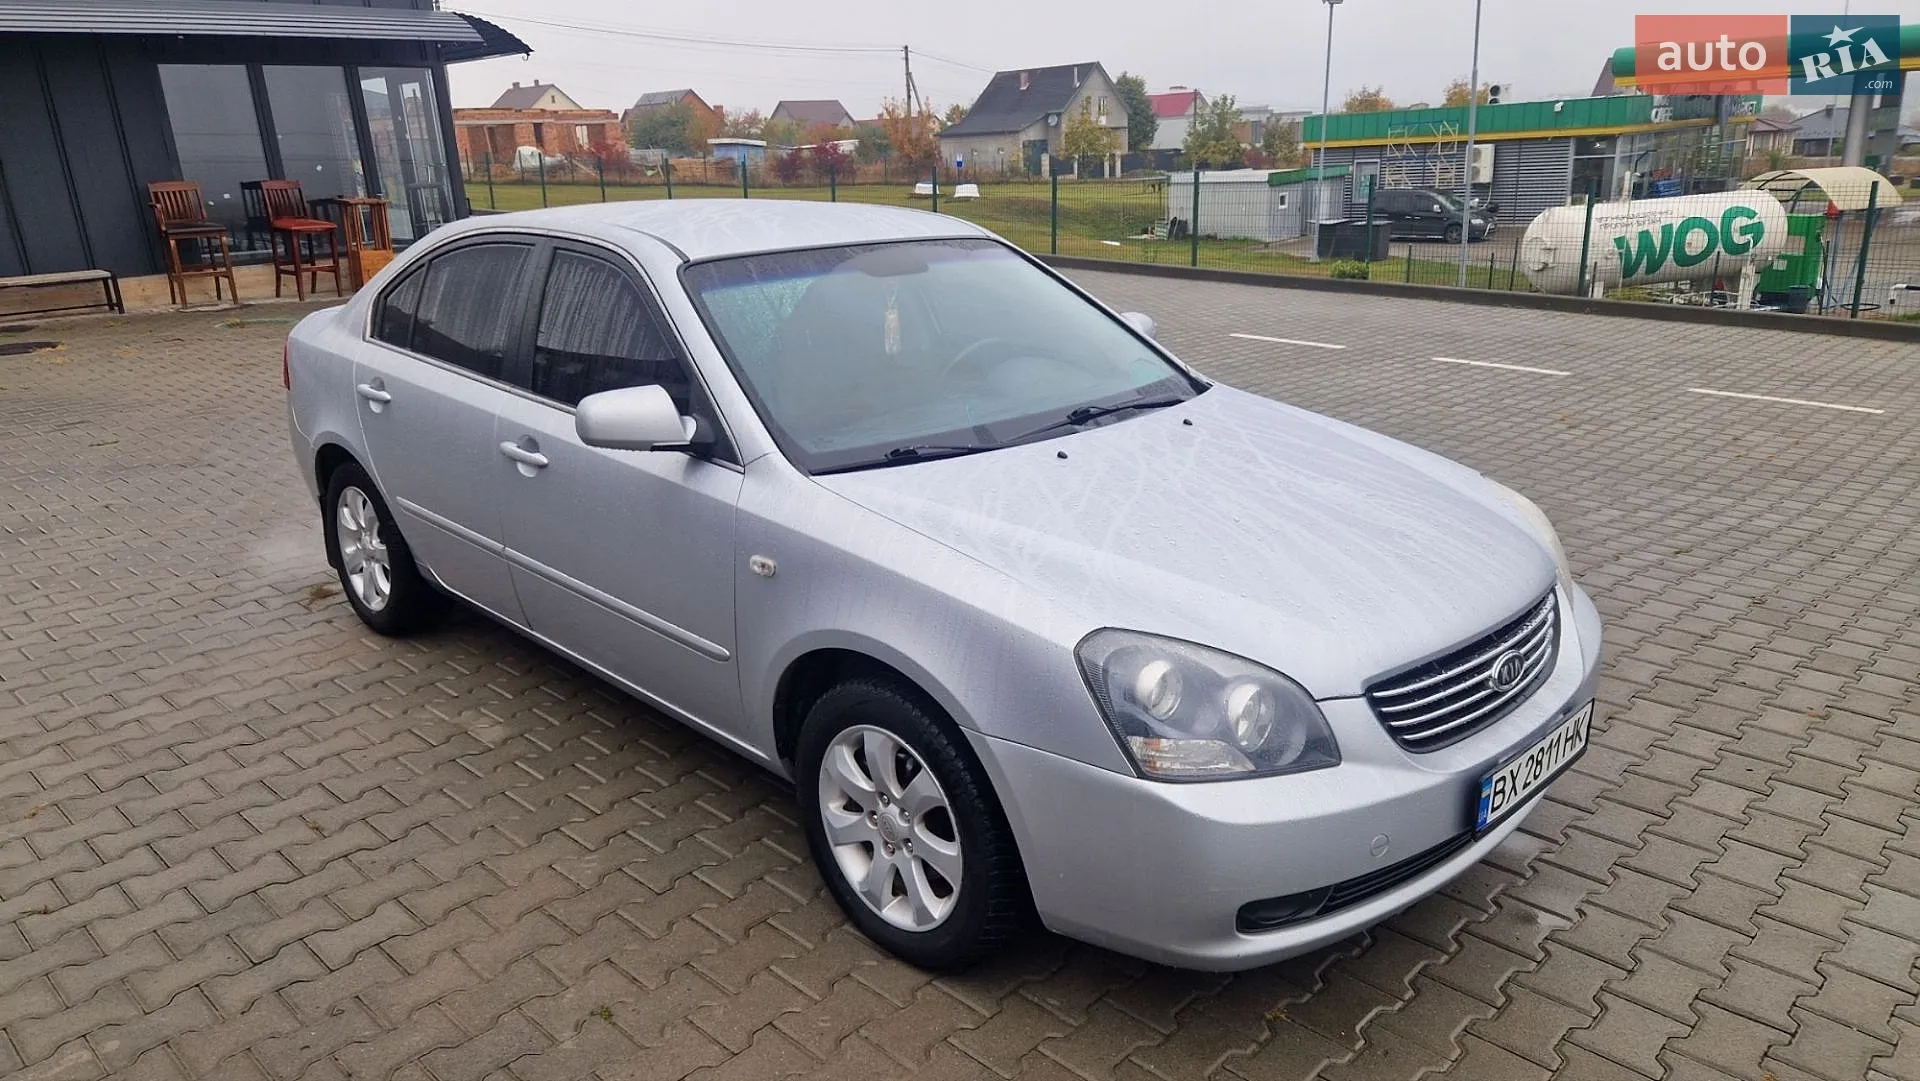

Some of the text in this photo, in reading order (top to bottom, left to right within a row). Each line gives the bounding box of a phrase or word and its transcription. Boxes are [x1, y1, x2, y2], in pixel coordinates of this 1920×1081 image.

[1613, 205, 1766, 280] WOG
[1491, 711, 1588, 814] BX 2811 HK
